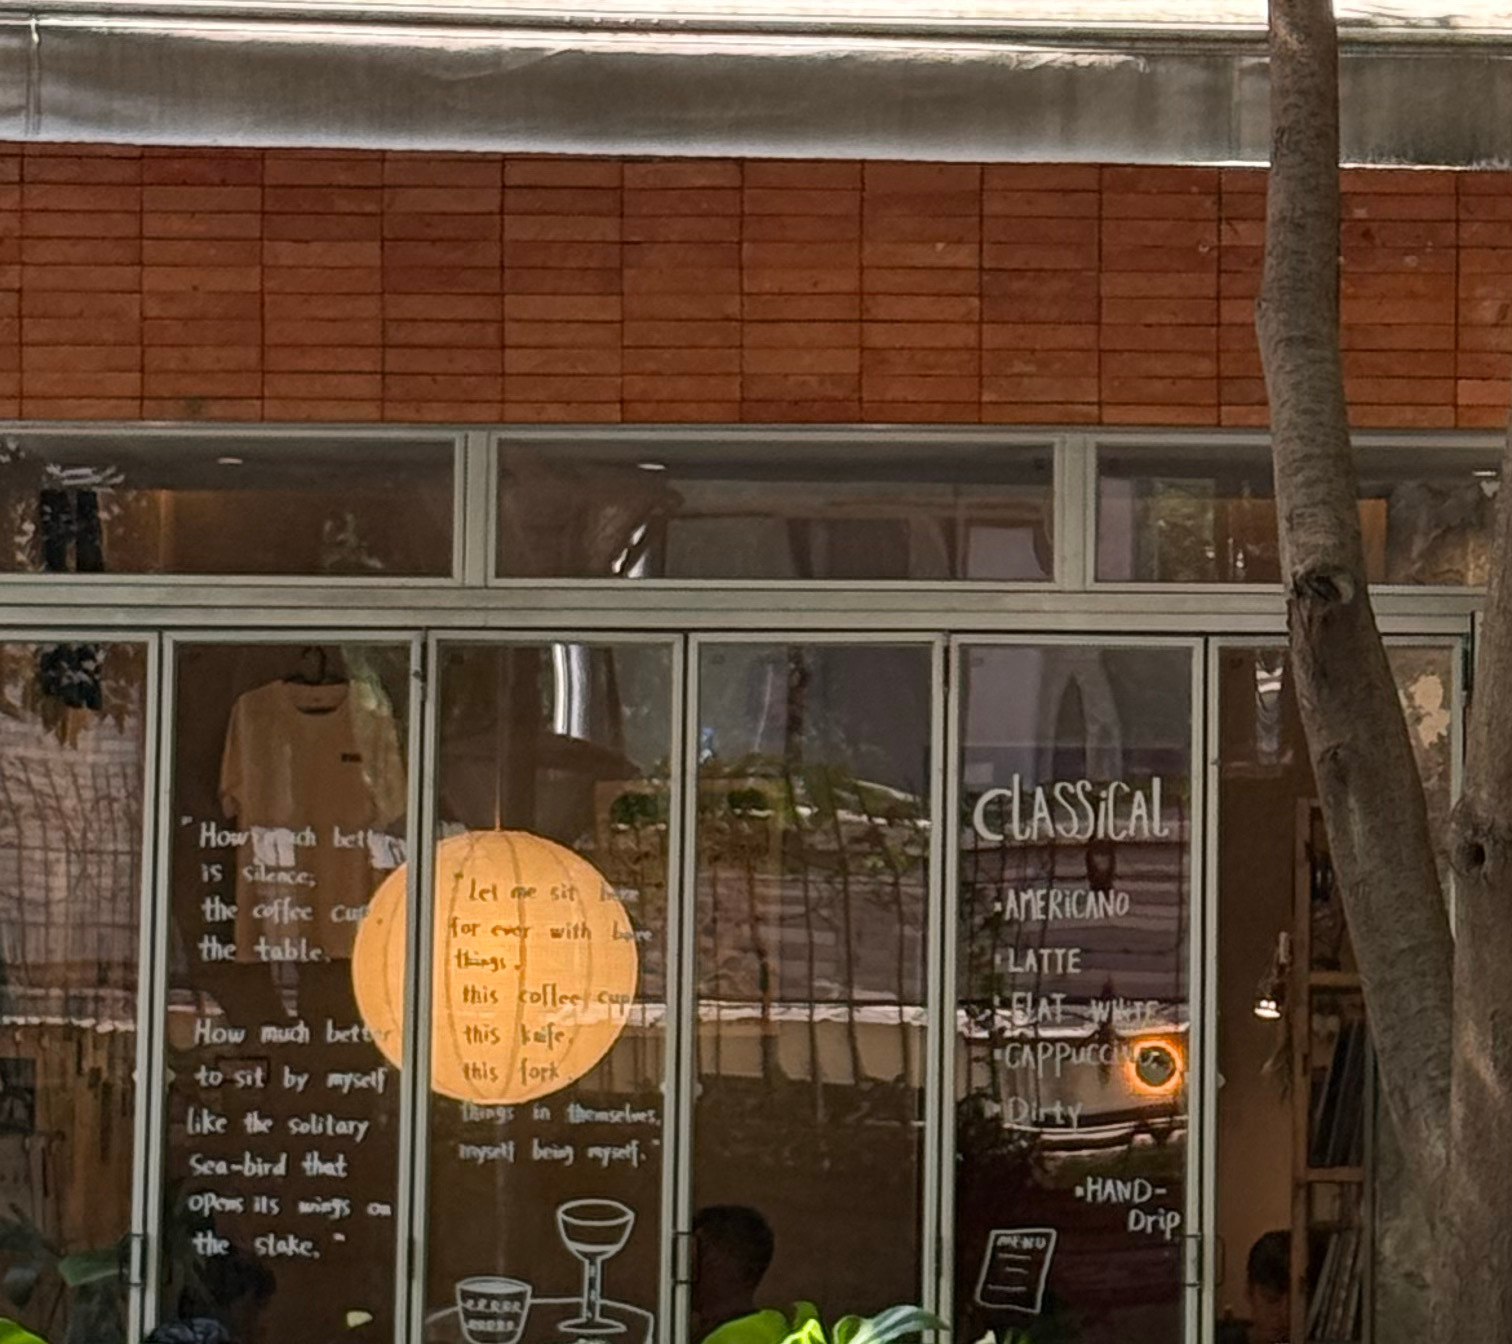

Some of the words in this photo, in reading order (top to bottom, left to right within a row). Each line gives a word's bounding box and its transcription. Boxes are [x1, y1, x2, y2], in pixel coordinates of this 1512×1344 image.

[201, 864, 223, 882] is
[510, 886, 537, 899] me
[550, 883, 577, 901] sit
[201, 895, 238, 922] the
[253, 897, 313, 924] coffee
[451, 916, 480, 938] for
[550, 922, 592, 940] with
[197, 935, 236, 962] the
[1007, 947, 1082, 975] LATTE
[463, 984, 499, 1004] this
[519, 983, 582, 1007] coffee
[194, 1018, 245, 1044] How
[261, 1020, 310, 1043] much
[464, 1024, 501, 1045] this
[195, 1065, 222, 1087] to
[235, 1067, 265, 1087] sit
[283, 1065, 310, 1092] by
[327, 1067, 388, 1093] myself
[463, 1062, 499, 1081] this
[186, 1106, 228, 1135] like
[243, 1110, 273, 1134] the
[288, 1113, 370, 1142] solitary
[462, 1103, 514, 1124] things
[533, 1103, 550, 1121] in
[1008, 1097, 1083, 1134] Dirty
[302, 1151, 348, 1178] that
[459, 1140, 515, 1165] myself
[532, 1137, 574, 1166] being
[253, 1195, 280, 1215] its
[298, 1197, 350, 1220] wings
[367, 1202, 392, 1216] on
[1128, 1209, 1181, 1240] Drip
[192, 1230, 230, 1256] the
